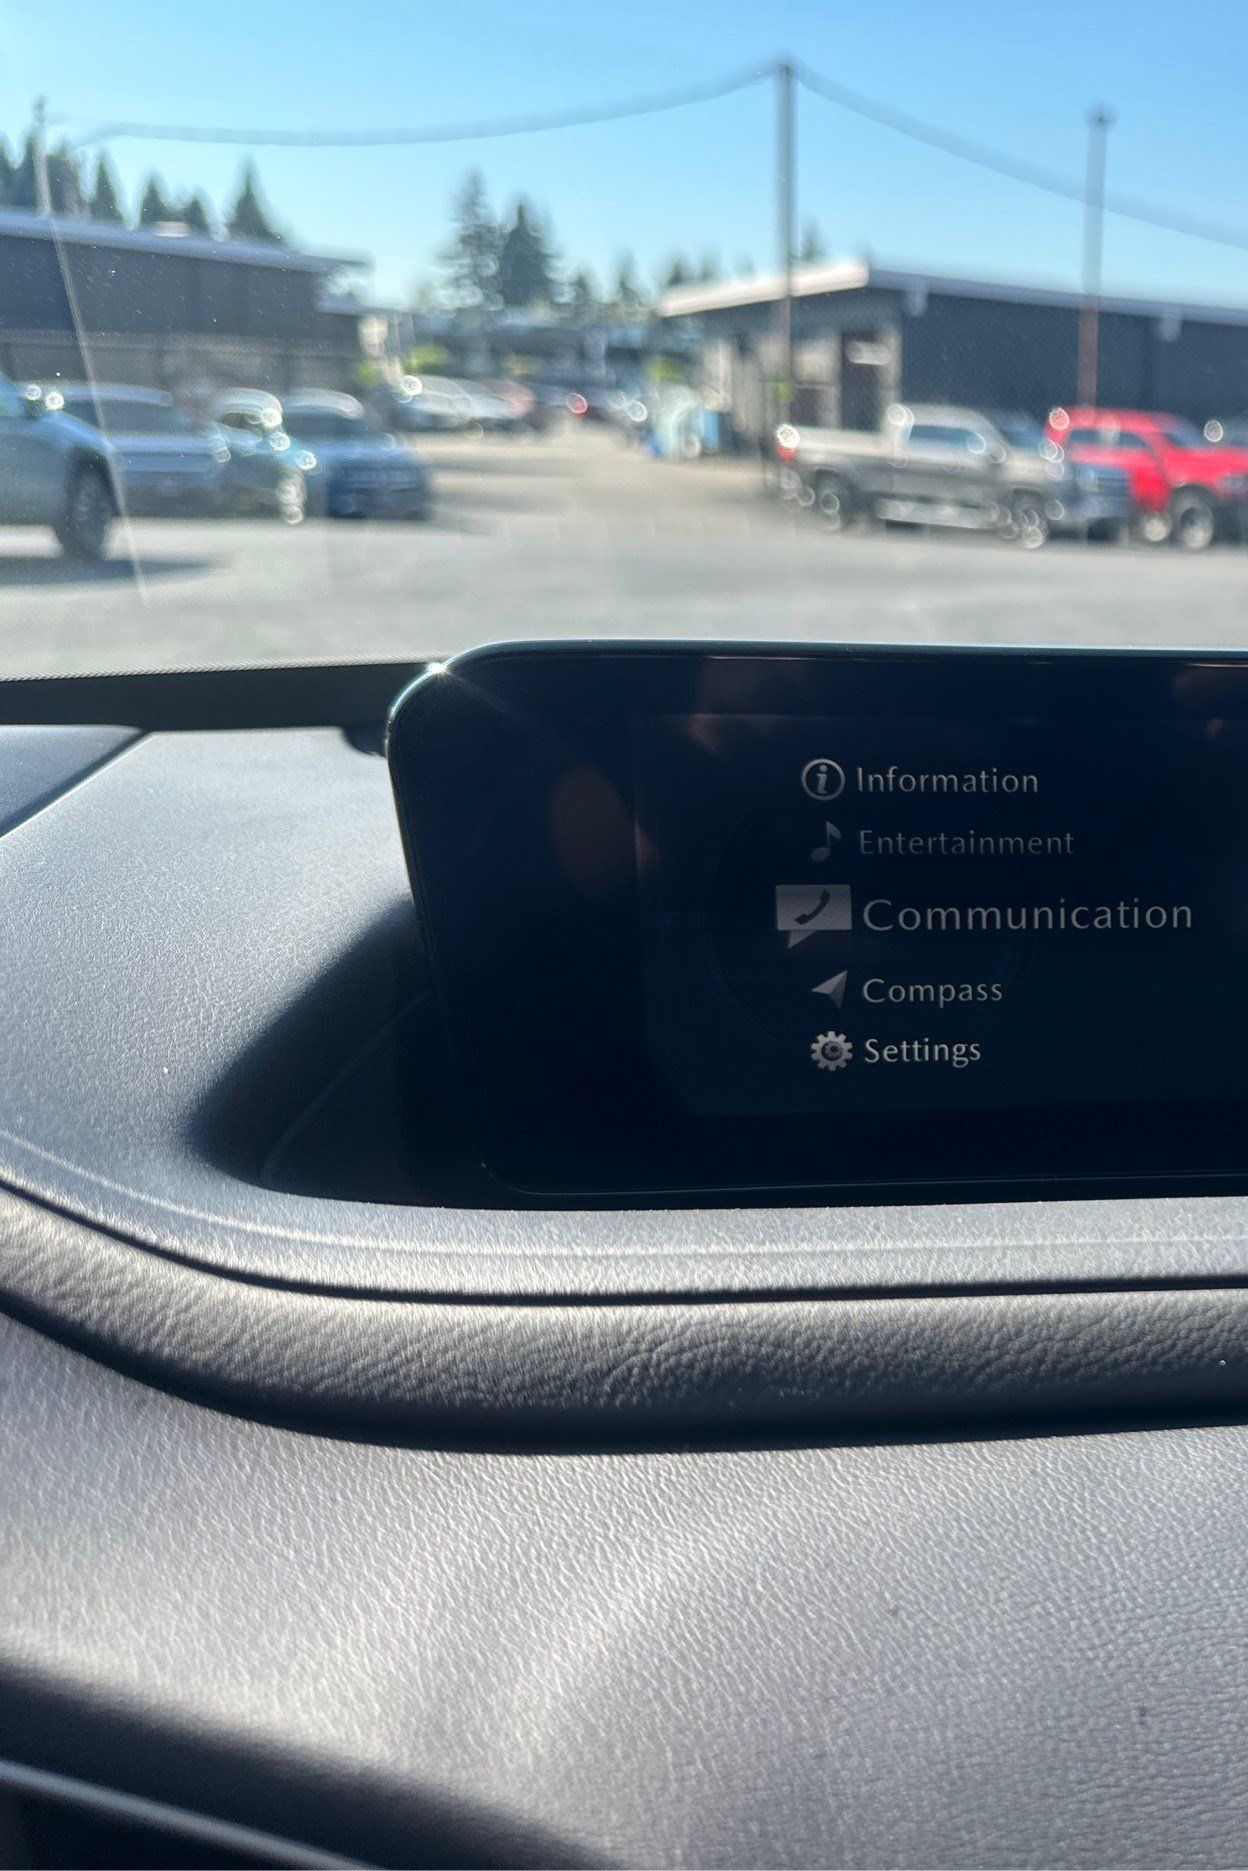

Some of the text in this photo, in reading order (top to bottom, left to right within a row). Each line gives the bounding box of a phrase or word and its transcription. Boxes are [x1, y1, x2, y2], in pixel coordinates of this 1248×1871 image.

[857, 765, 1038, 794] Information
[859, 829, 1074, 855] Entertainment
[862, 897, 1192, 932] Communication
[862, 977, 1003, 1009] Compass
[864, 1037, 981, 1069] Settings
